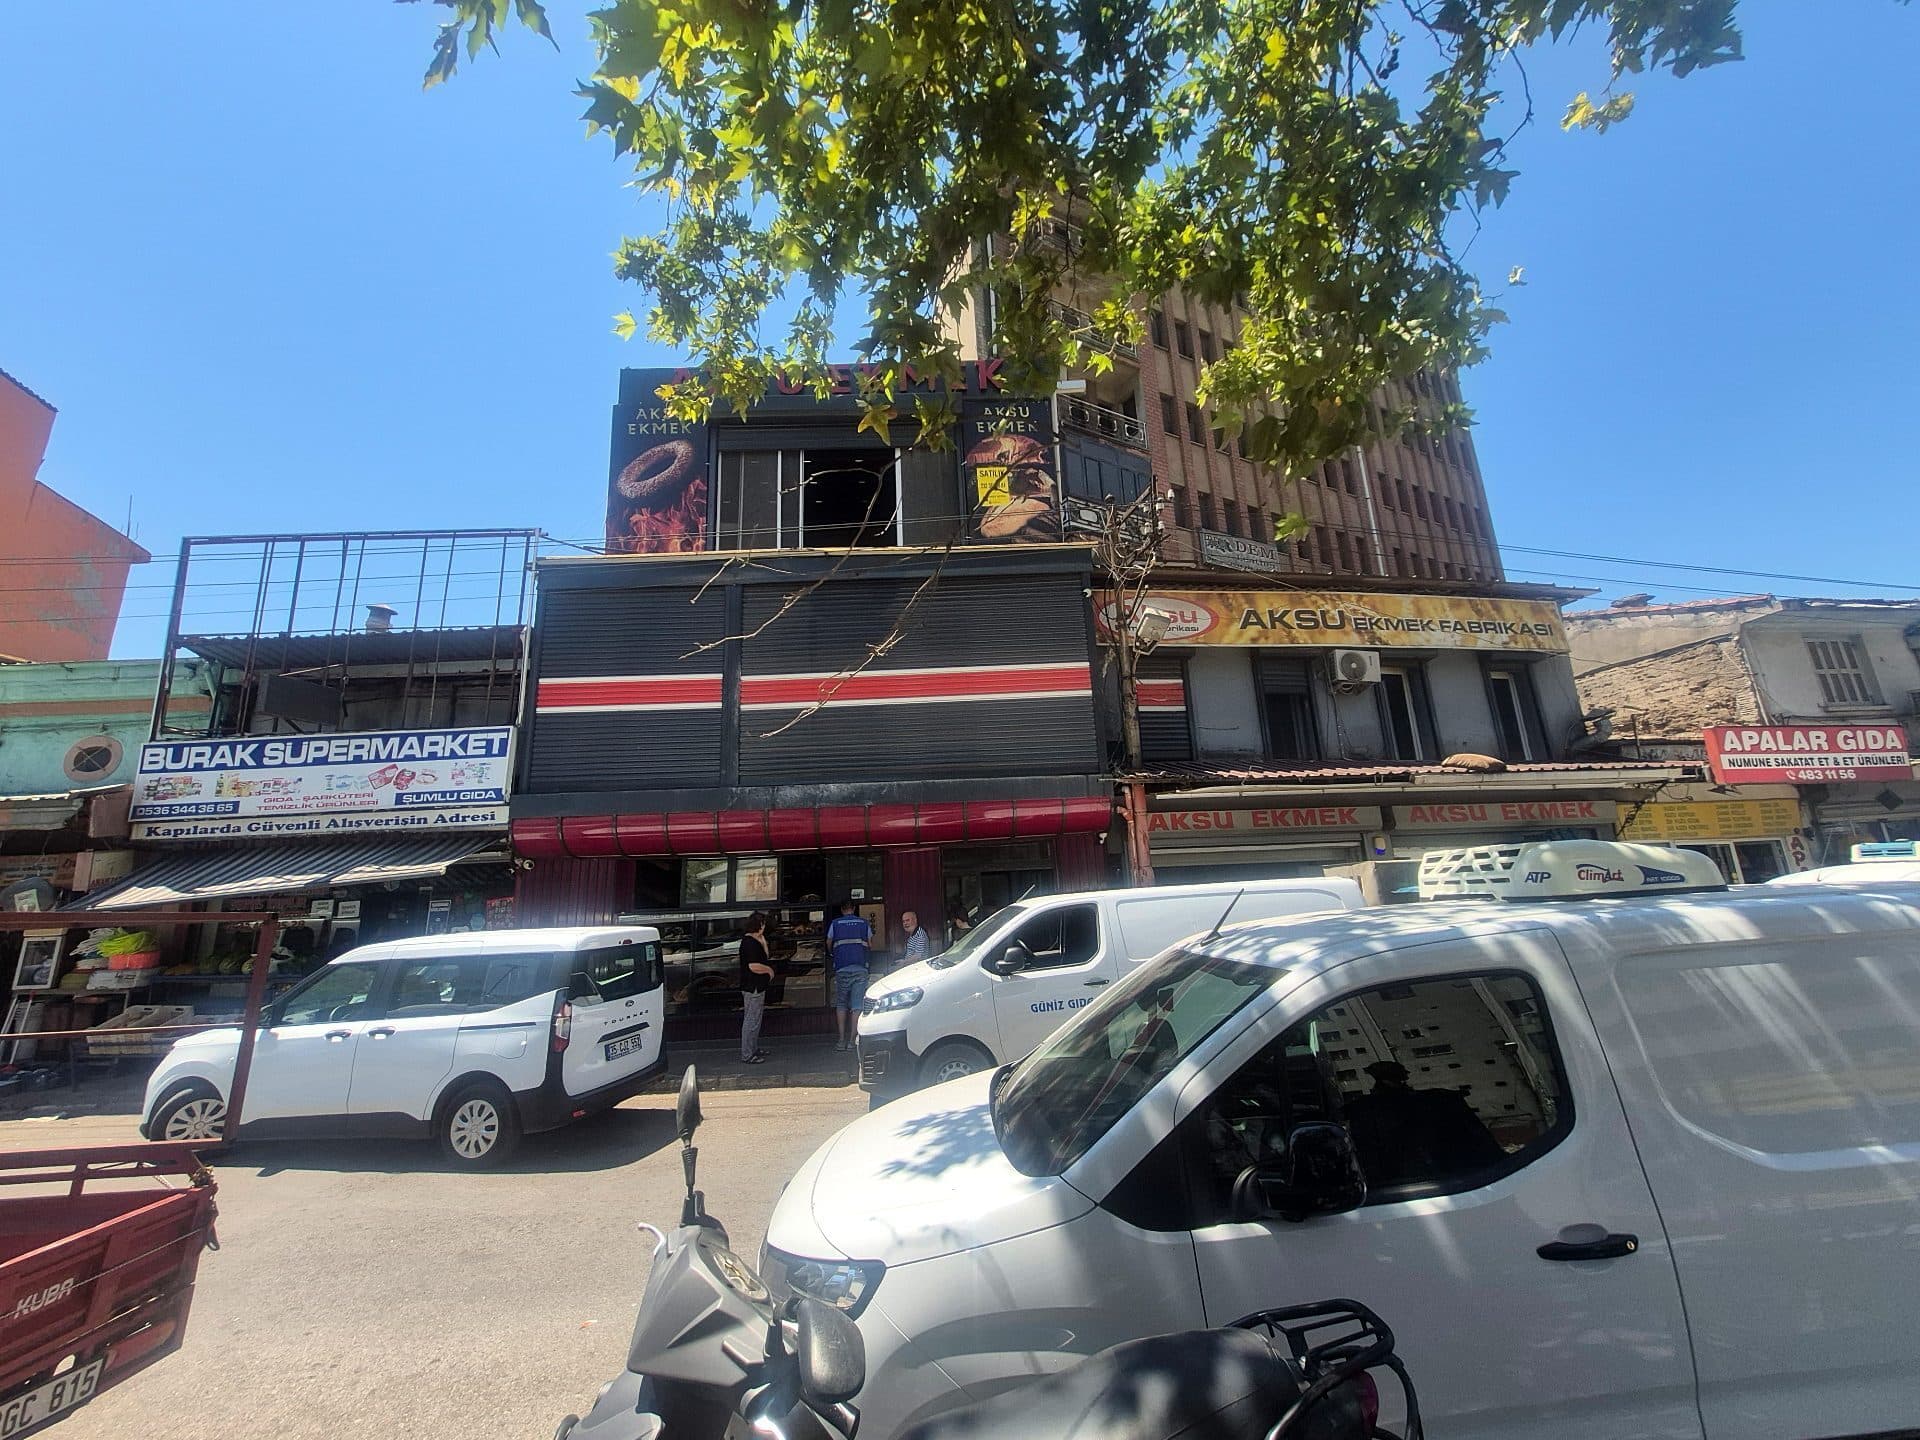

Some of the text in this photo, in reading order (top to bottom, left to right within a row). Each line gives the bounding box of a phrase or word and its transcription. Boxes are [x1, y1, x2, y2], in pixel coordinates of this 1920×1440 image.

[627, 422, 692, 435] EKMEK
[1239, 607, 1346, 631] AKSU
[1352, 615, 1437, 633] EKMEK
[141, 731, 508, 771] BURAK SÜPERMARKET
[1724, 729, 1903, 751] APALAR GIDA
[1727, 754, 1906, 768] NUMUNE SAKATAT ET & ET ÜRÜNLERİ
[1797, 769, 1857, 780] 483 11 56
[459, 790, 497, 800] GIDA
[136, 806, 170, 816] 0536
[171, 805, 197, 815] 344
[216, 803, 234, 812] 65
[1148, 807, 1360, 832] AKSU EKMEK
[1409, 802, 1599, 824] AKSU EKMEK
[145, 811, 497, 838] Kapılarda Güvenli Alışverişin Adresi
[1524, 871, 1552, 884] ATP
[1030, 999, 1065, 1013] GÜNİZ
[14, 1277, 75, 1319] KUBA
[0, 1364, 99, 1438] GC 815
